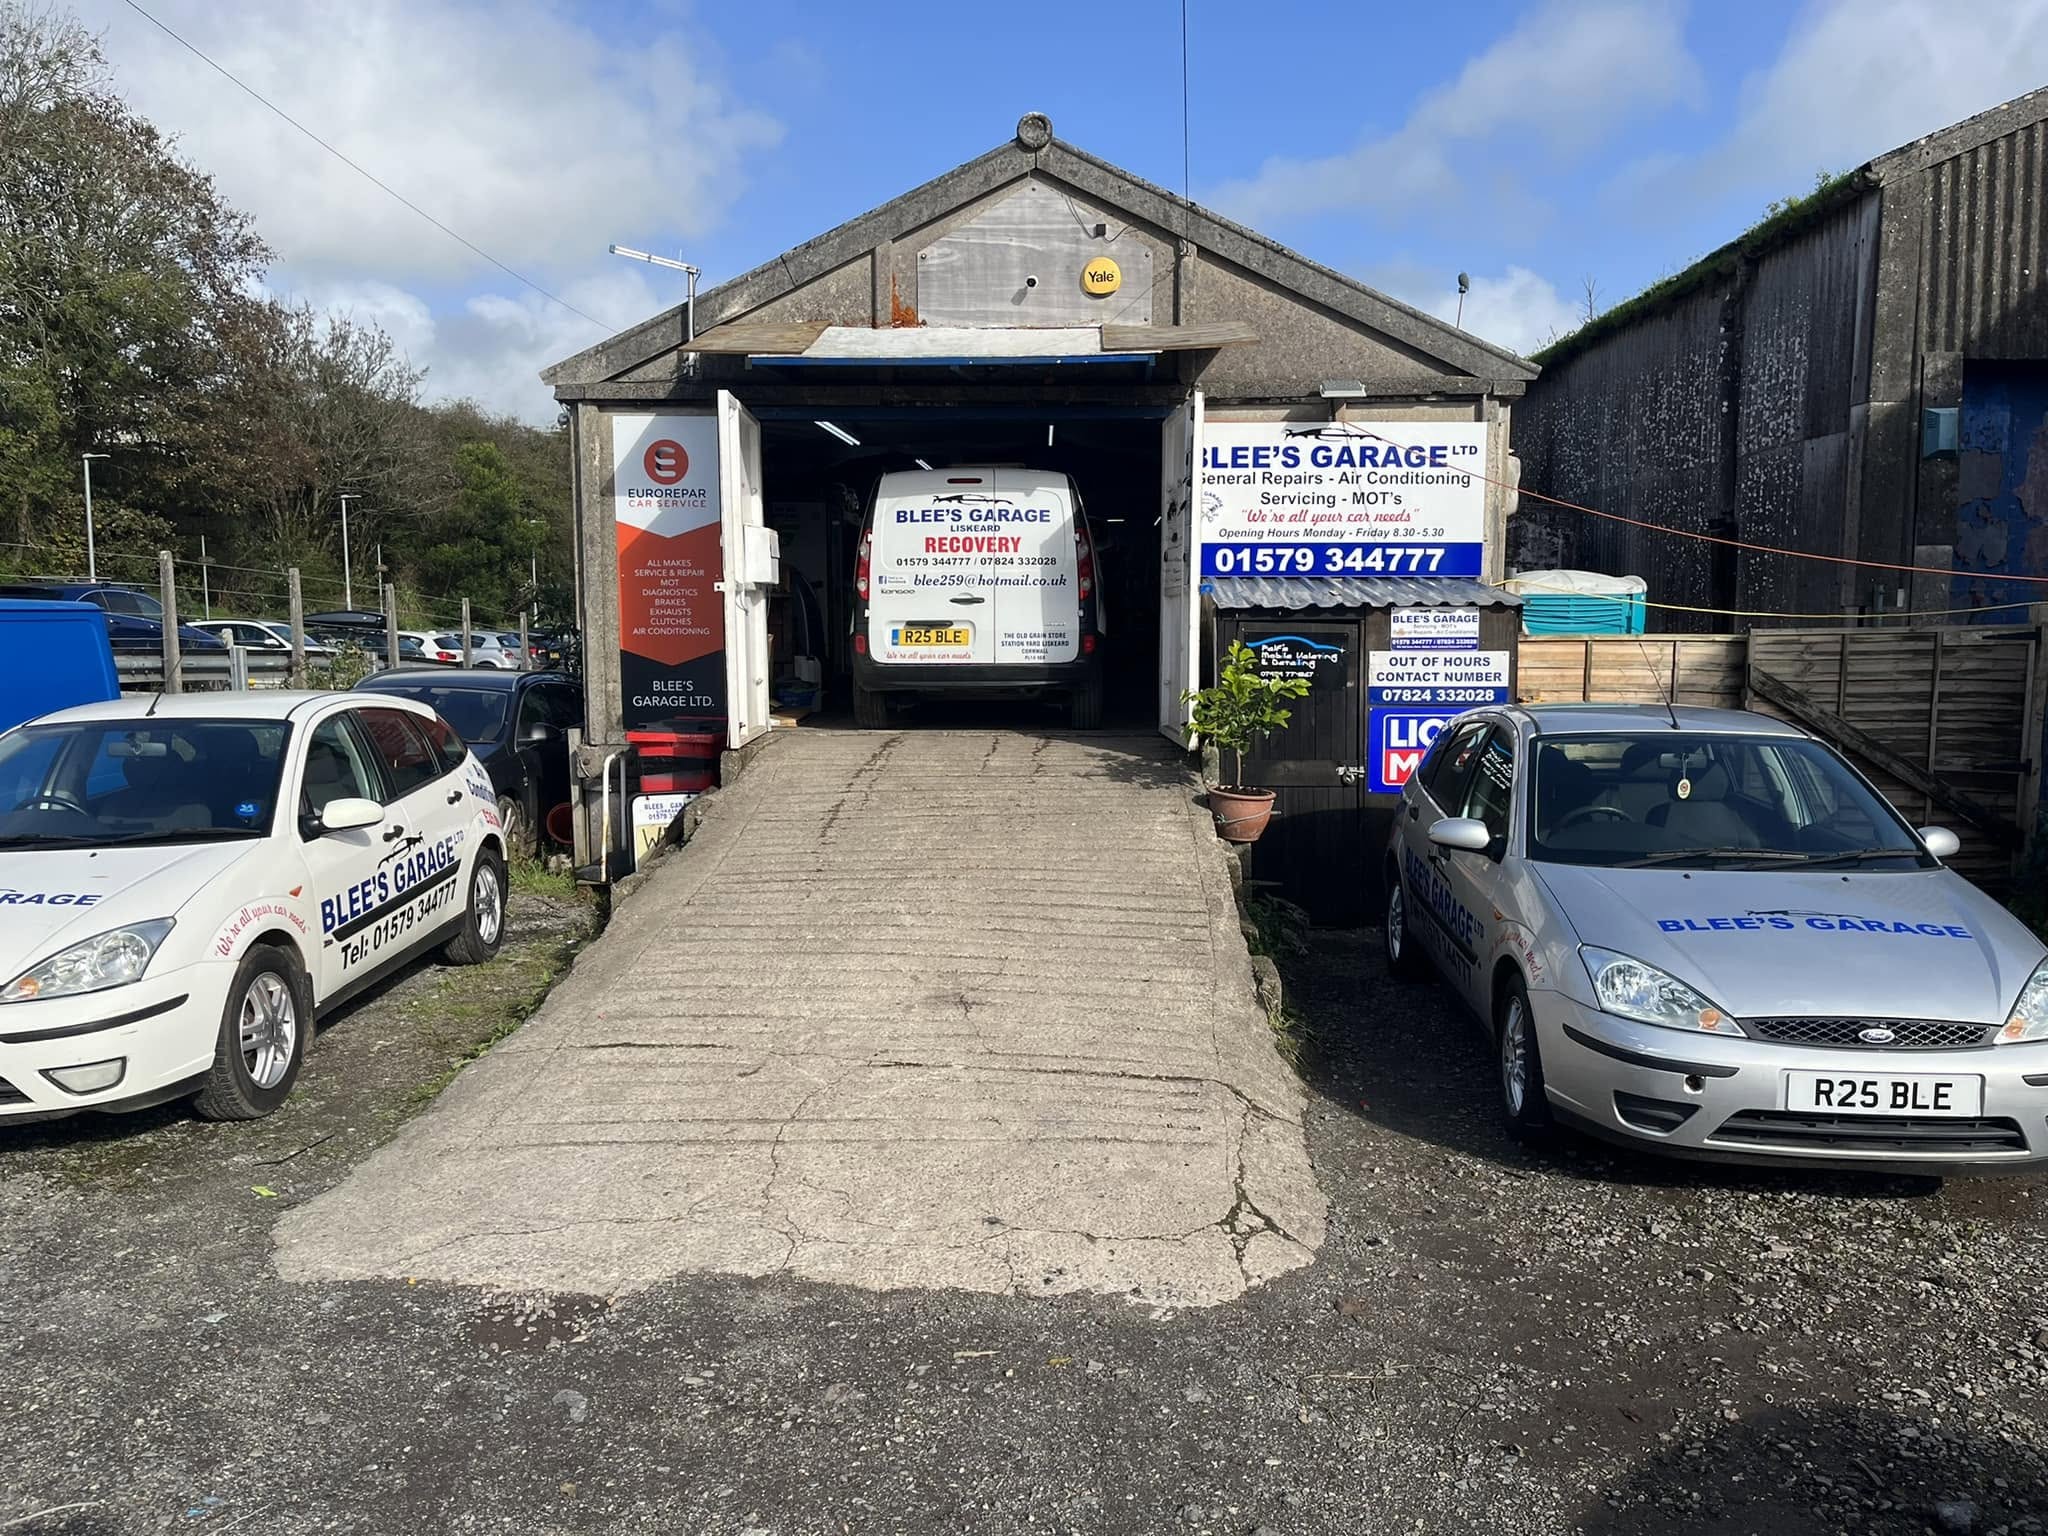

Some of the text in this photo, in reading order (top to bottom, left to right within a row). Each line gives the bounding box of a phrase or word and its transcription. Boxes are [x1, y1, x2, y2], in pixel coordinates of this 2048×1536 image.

[1088, 271, 1114, 283] Yale
[1310, 445, 1448, 469] GARAGE
[1452, 445, 1478, 456] LTD
[1262, 472, 1323, 488] Repairs
[1338, 472, 1363, 485] Air
[1367, 471, 1471, 488] Conditioning
[628, 488, 706, 498] EUROREPAR
[628, 500, 706, 508] CAR SERVICE
[1260, 492, 1337, 508] Servicing
[1352, 492, 1403, 505] MOT's
[896, 509, 1050, 523] BLEE'S GARAGE
[1291, 509, 1308, 523] all
[1311, 513, 1343, 526] your
[1347, 513, 1370, 523] car
[1219, 528, 1264, 540] Opening
[1267, 528, 1300, 538] Hours
[1303, 528, 1346, 540] Monday
[1356, 528, 1390, 539] Friday
[925, 536, 1022, 553] RECOVERY
[896, 558, 929, 566] 01579
[932, 558, 970, 566] 344777
[980, 557, 1014, 566] 07824
[1017, 557, 1057, 566] 332028
[1215, 547, 1445, 572] 01579 344777
[913, 574, 1067, 588] blee259@hotmail.co.uk
[650, 608, 691, 616] EXHAUSTS
[1392, 615, 1478, 623] BLEE'S GARAGE
[905, 630, 962, 643] R25 BLE
[1296, 652, 1338, 663] Valeting
[1389, 656, 1490, 667] OUT OF HOURS
[1376, 671, 1502, 682] CONTACT NUMBER
[653, 681, 693, 692] BLEE'S
[632, 695, 715, 707] GARAGE LTD.
[1382, 689, 1495, 702] 07824 332028
[321, 830, 465, 934] BLEE'S GARAGE LTD
[239, 908, 252, 927] all
[251, 904, 273, 921] your
[274, 905, 288, 917] car
[1432, 877, 1473, 947] GARAGE
[341, 878, 457, 970] Tel: 01579 344777
[1657, 917, 1976, 939] BLEE'S GARAGE
[1815, 1078, 1954, 1111] R25 BLE
